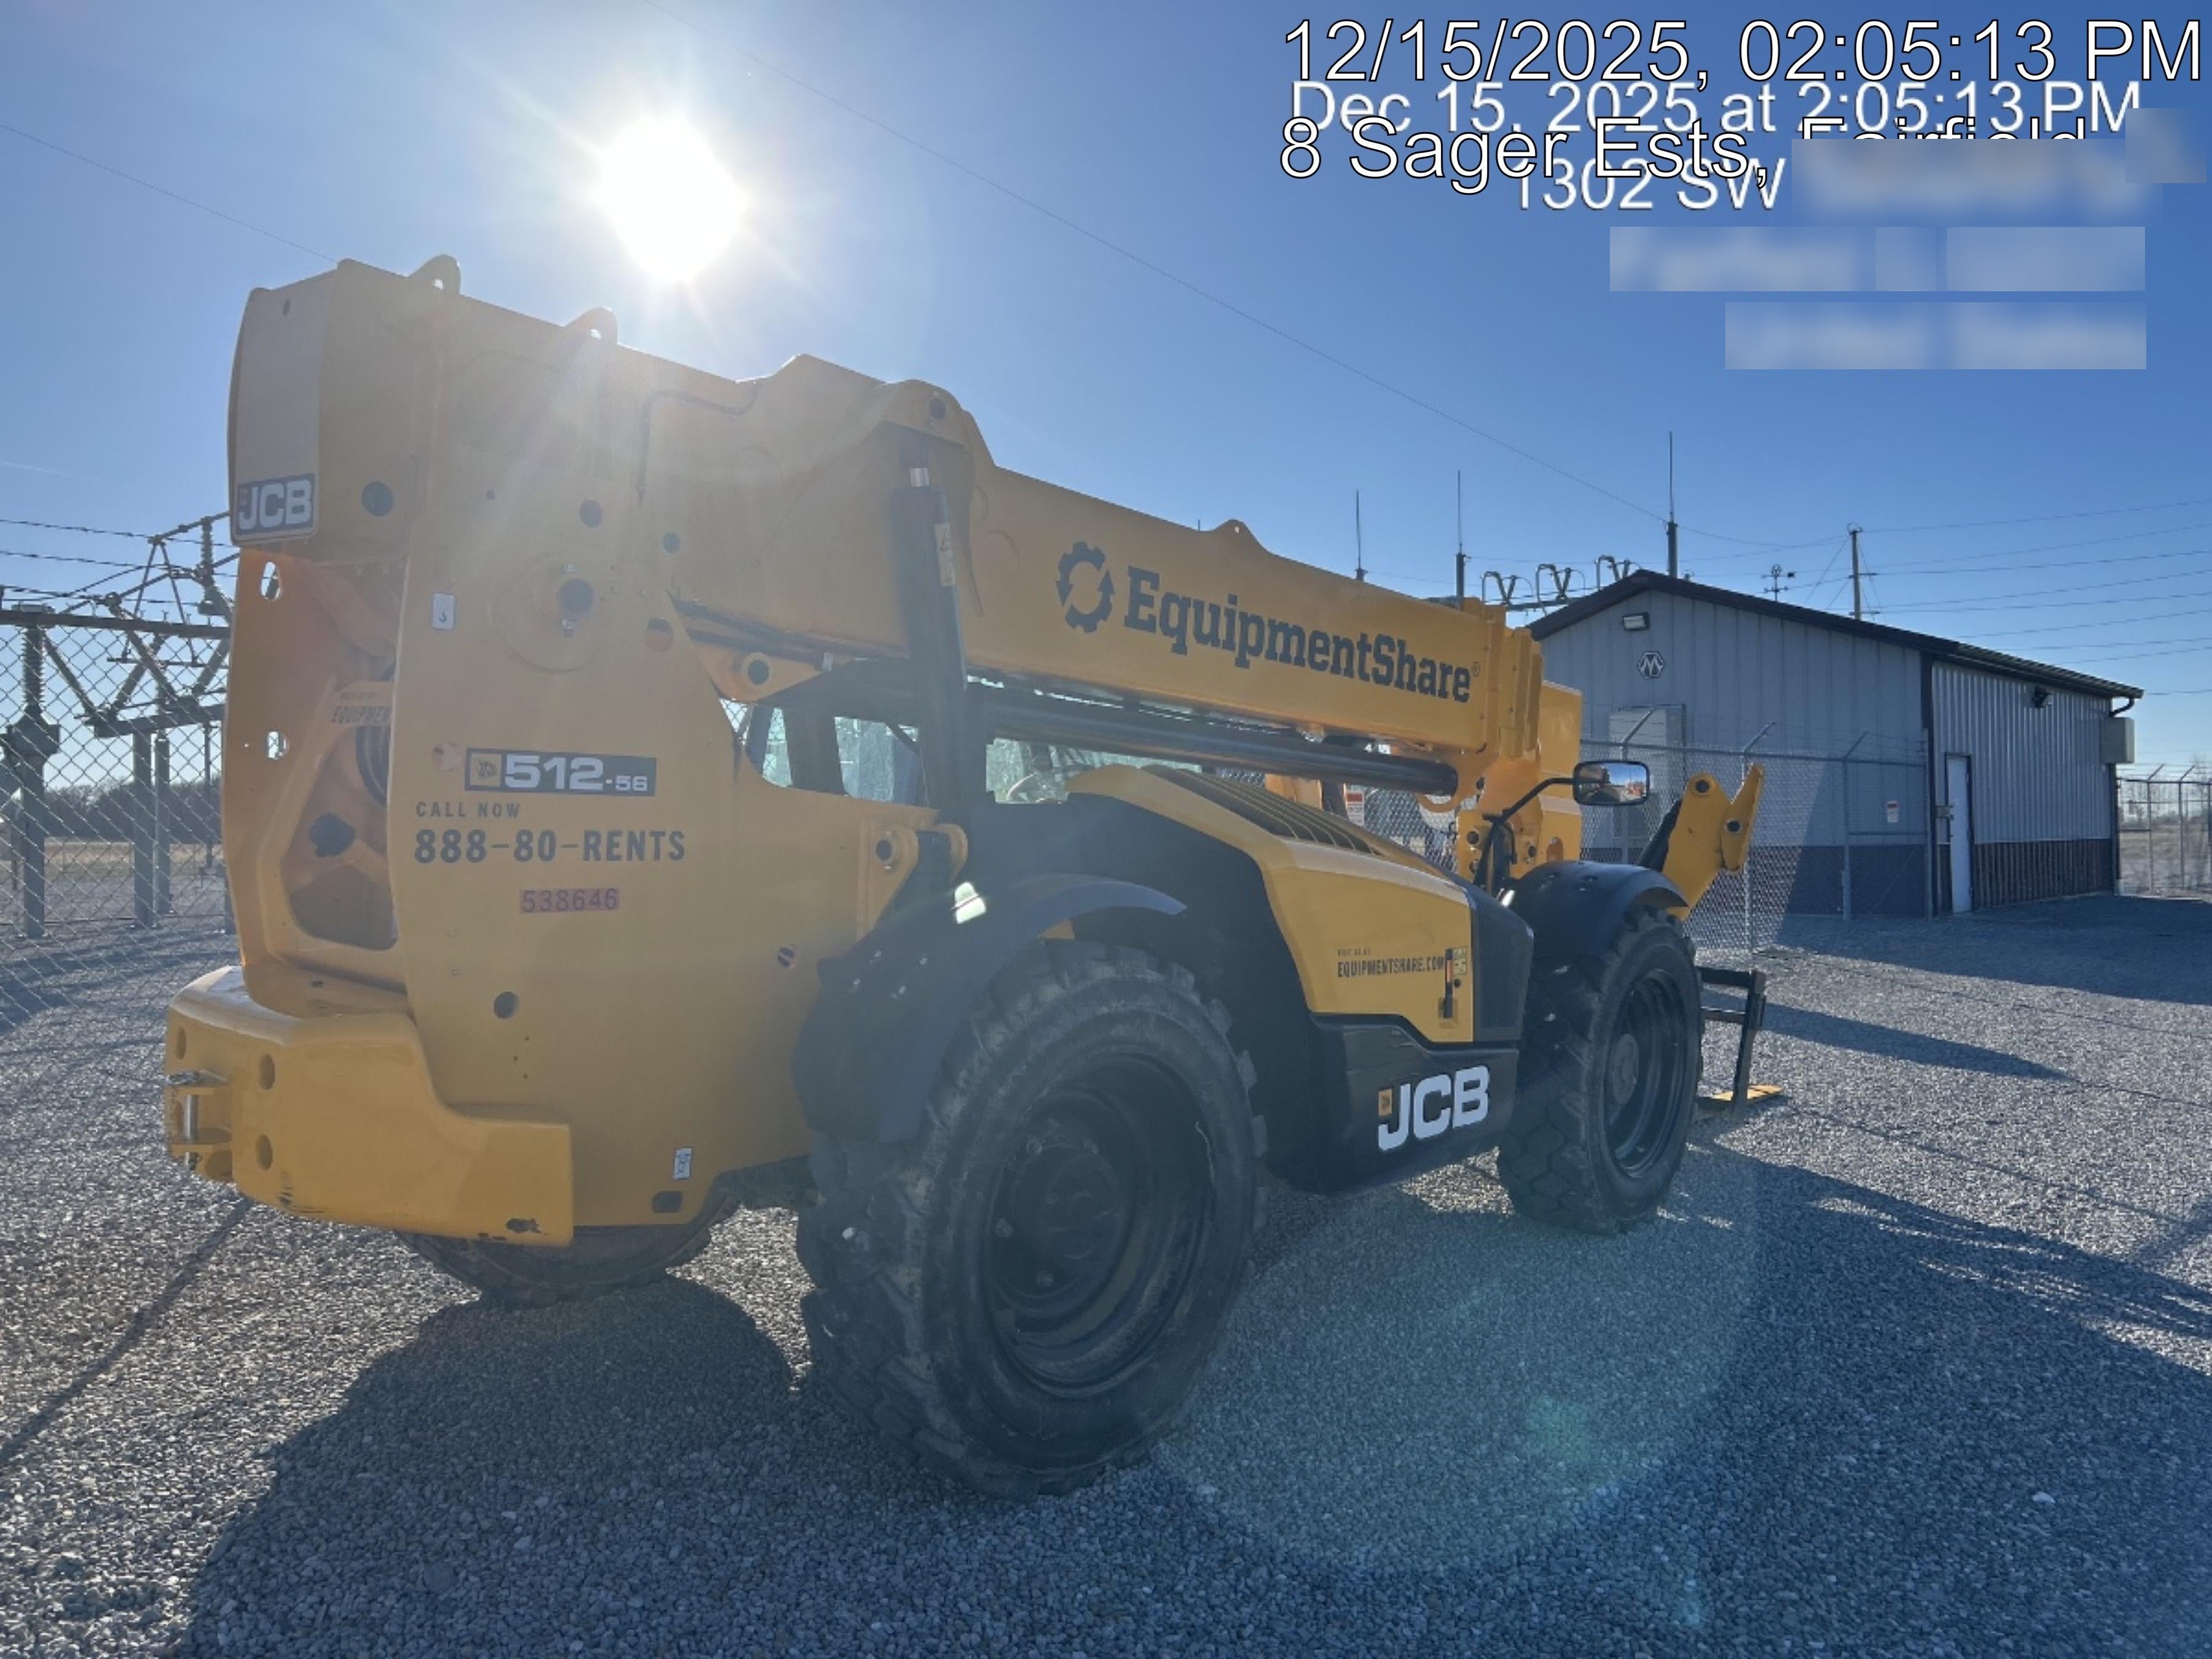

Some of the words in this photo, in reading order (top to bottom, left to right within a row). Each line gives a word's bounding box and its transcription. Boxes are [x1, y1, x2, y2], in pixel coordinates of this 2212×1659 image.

[238, 479, 312, 530] JCB
[416, 801, 466, 817] CALL
[478, 803, 520, 818] NOW
[415, 829, 685, 863] 888-80-RENTS
[522, 888, 617, 912] 538646
[1338, 955, 1445, 978] EQUIPMENTSHARE.COM
[1378, 1065, 1490, 1151] JCB
